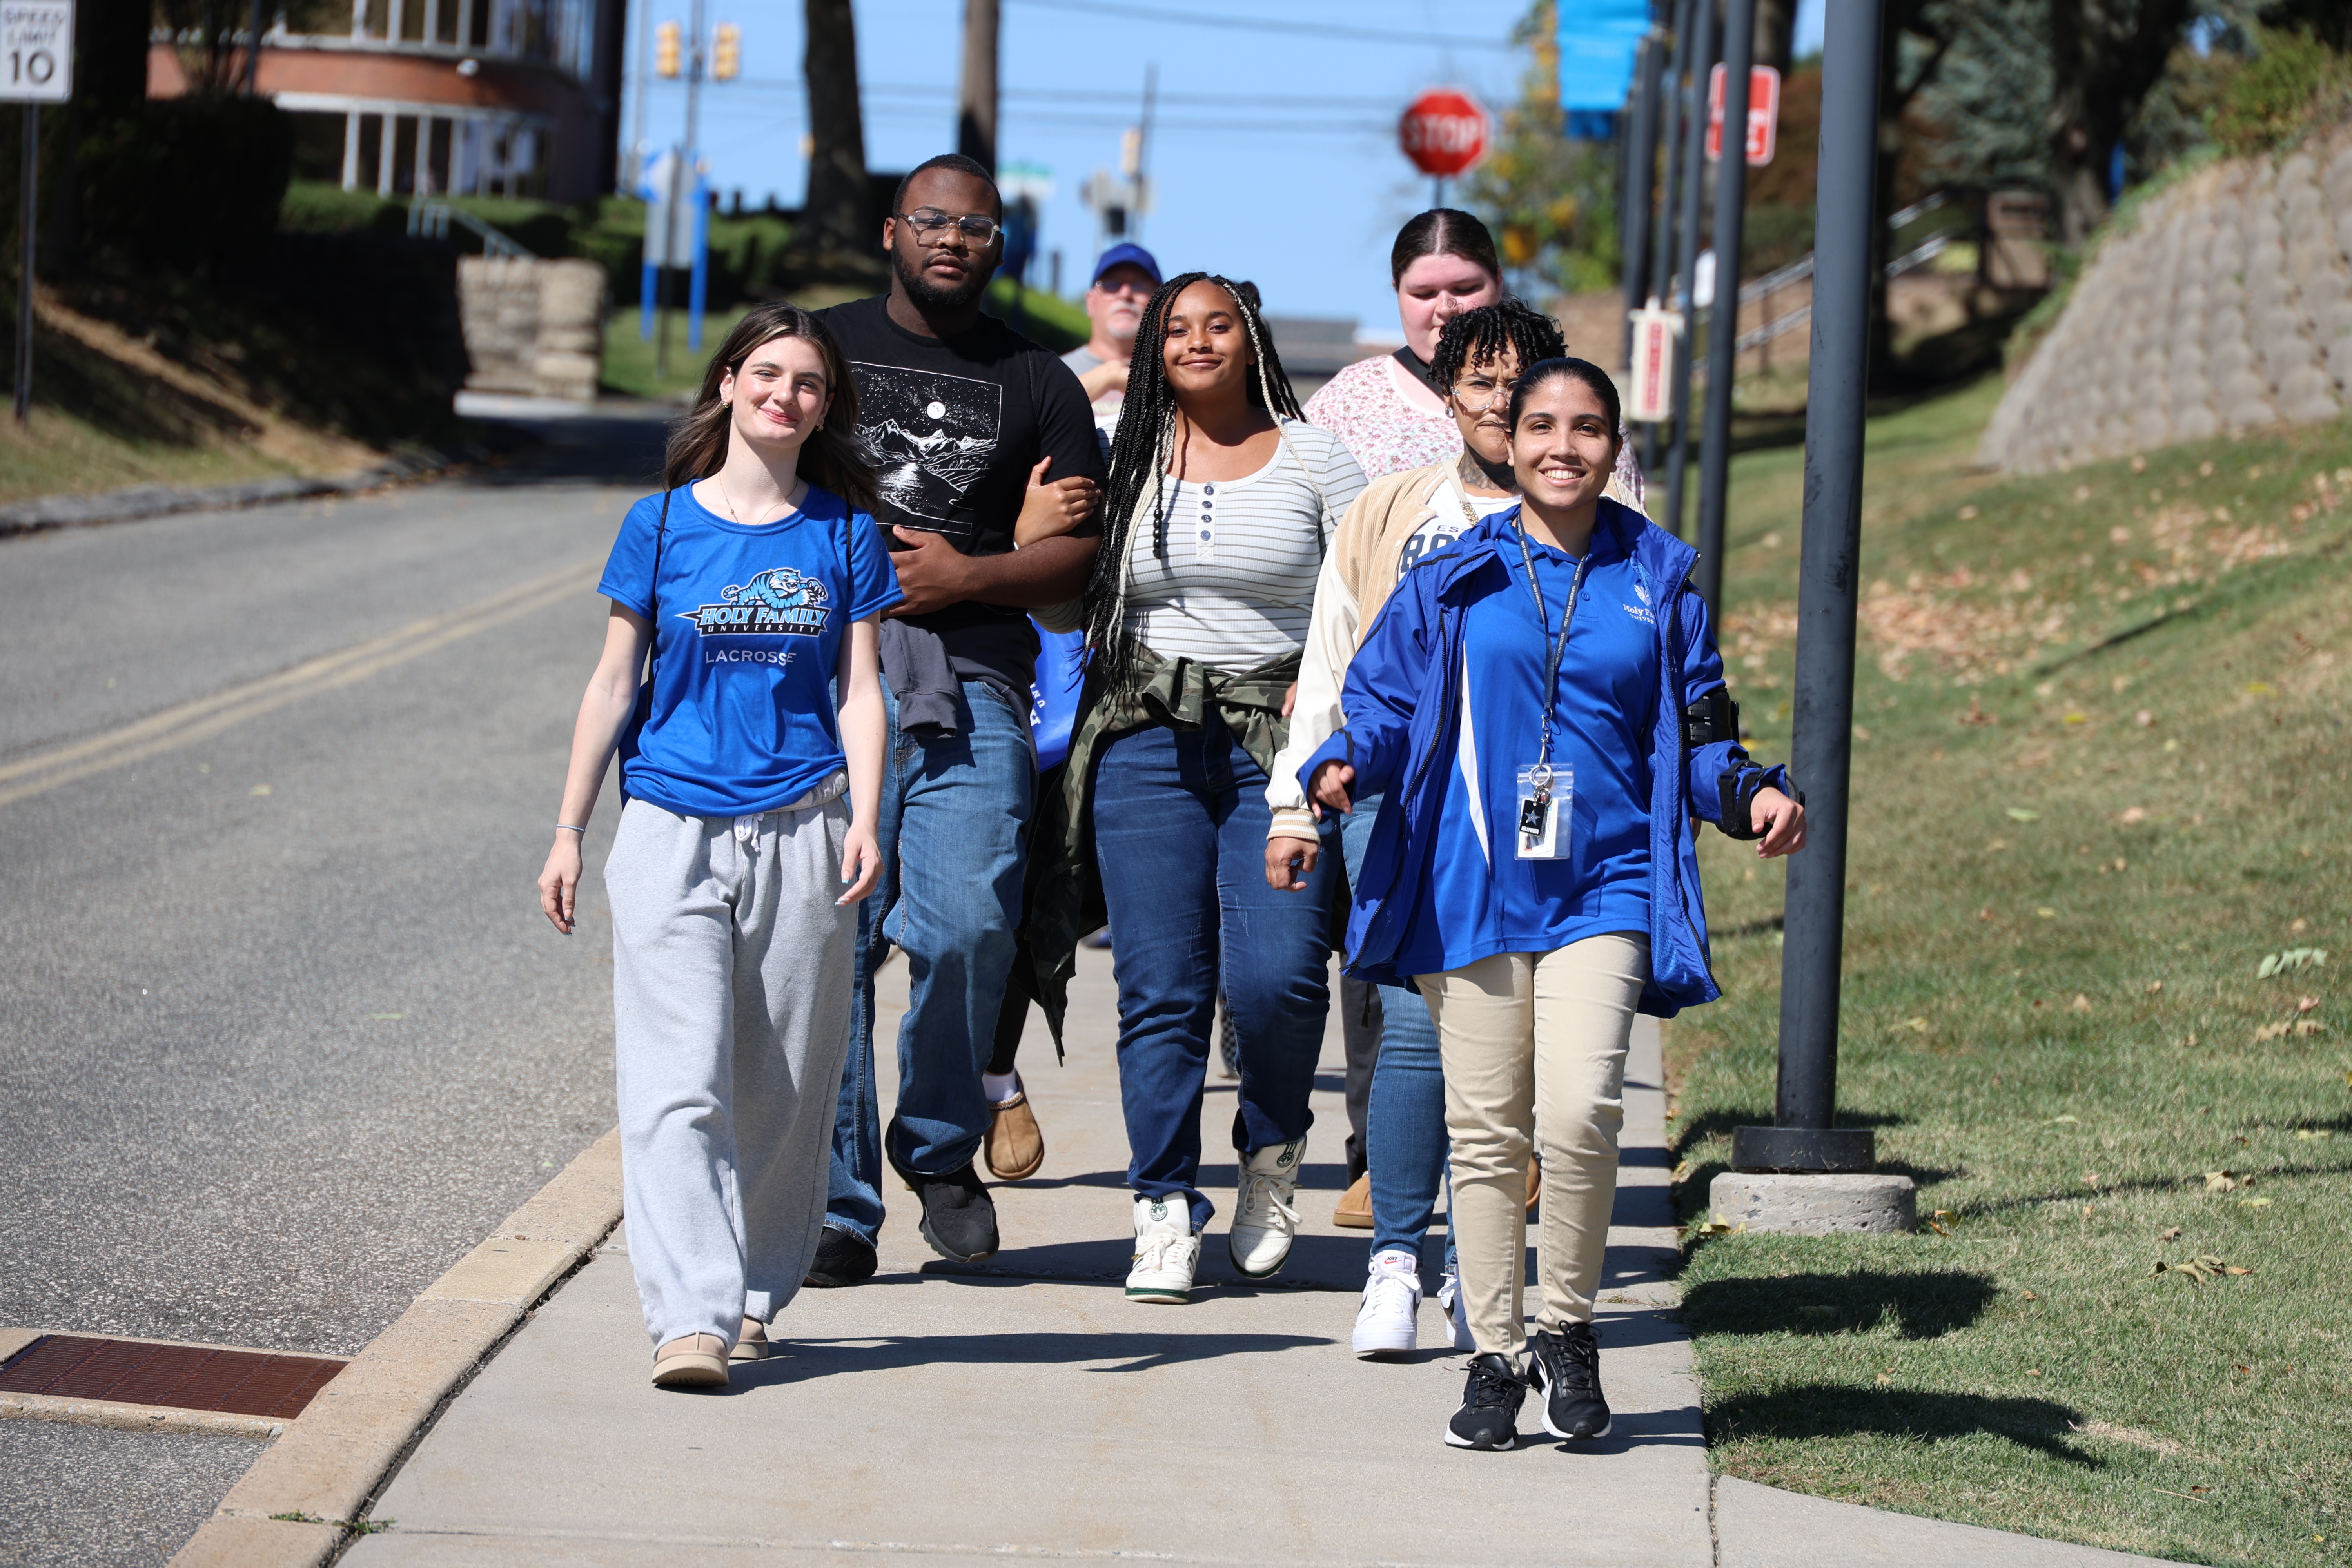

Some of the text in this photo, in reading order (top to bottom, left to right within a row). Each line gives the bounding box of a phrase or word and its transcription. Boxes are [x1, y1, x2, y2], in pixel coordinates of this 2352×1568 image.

[3, 8, 65, 25] SPEED
[7, 28, 56, 46] LIMIT
[9, 49, 54, 85] 10
[1404, 114, 1478, 153] STOP
[1526, 560, 1534, 579] UNIVERSITY
[699, 607, 826, 626] HOLY FAMILY
[1622, 604, 1644, 616] Holy
[708, 625, 815, 633] UNIVERSITY
[706, 650, 797, 666] LACROSSE
[1521, 826, 1539, 834] HOLLYWOOD
